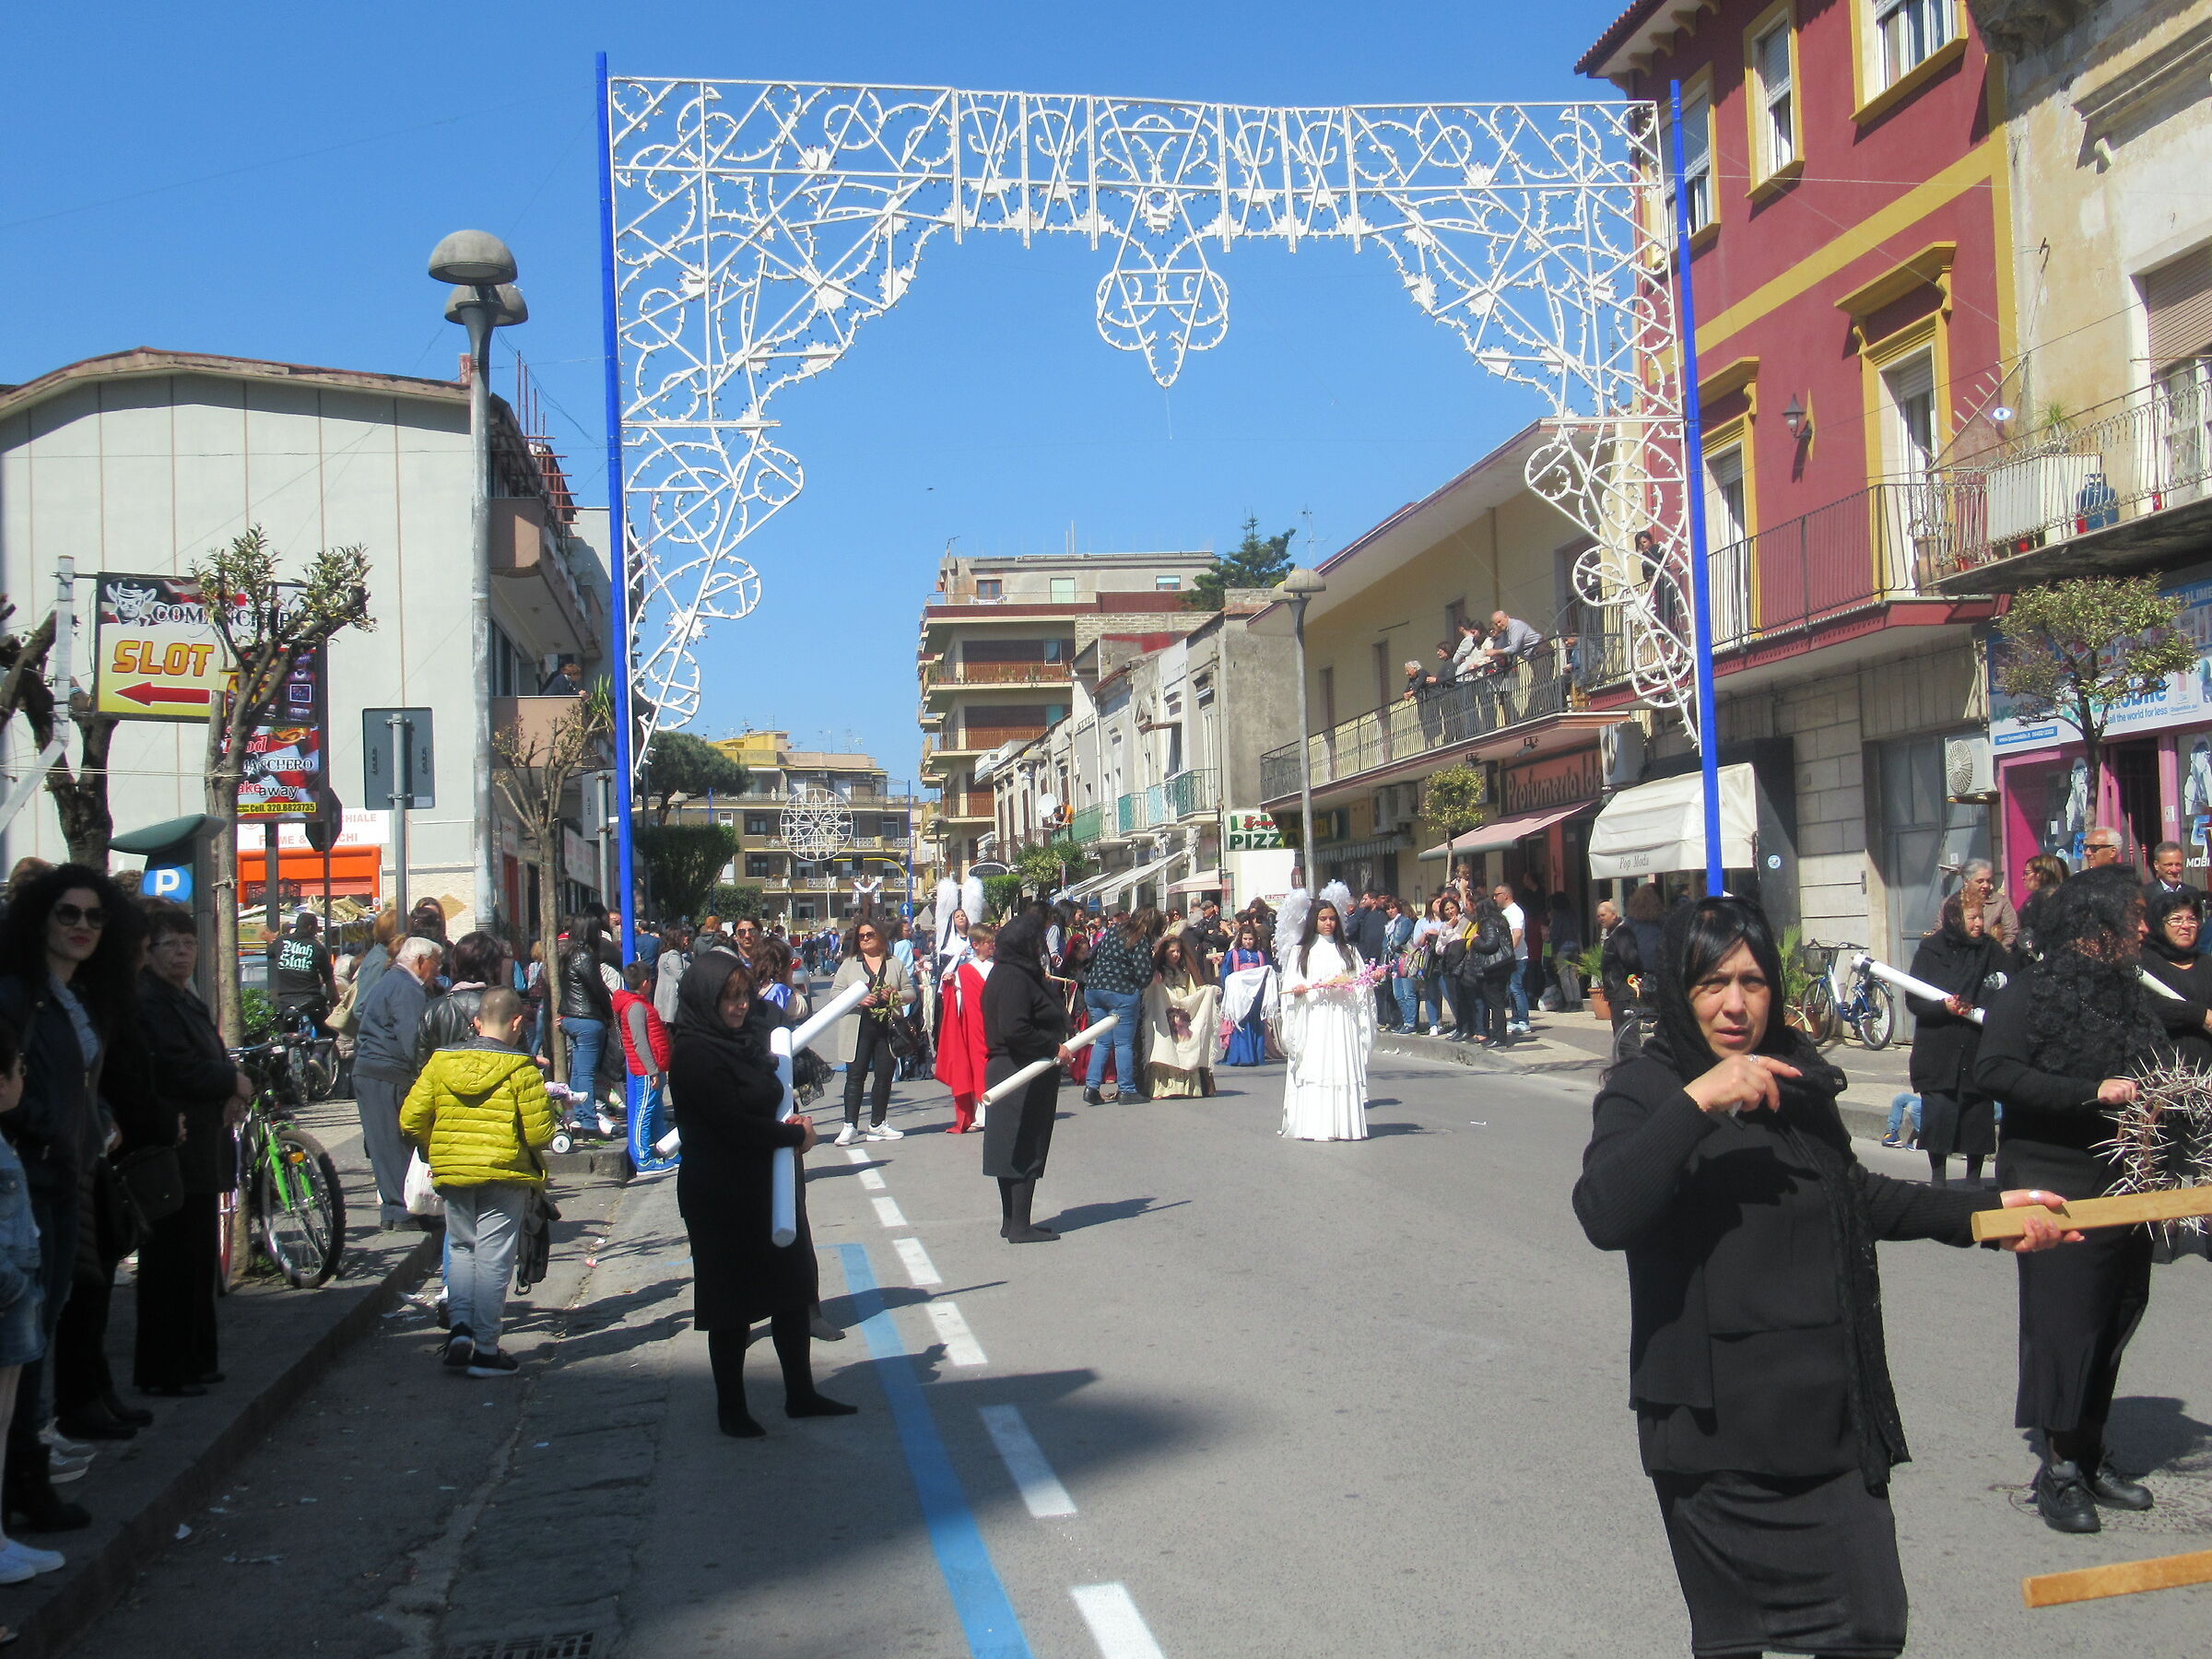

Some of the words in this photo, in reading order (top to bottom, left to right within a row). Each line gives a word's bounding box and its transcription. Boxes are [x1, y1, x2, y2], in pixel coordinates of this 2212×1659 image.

[112, 640, 215, 677] SLOT
[2116, 712, 2126, 722] the
[2127, 709, 2144, 721] world
[2145, 708, 2154, 717] for
[2155, 706, 2168, 716] less
[238, 780, 261, 794] ake
[259, 786, 300, 799] away
[1507, 768, 1578, 813] Profumeria
[155, 868, 180, 896] P
[282, 939, 313, 959] Utah
[277, 954, 312, 971] State
